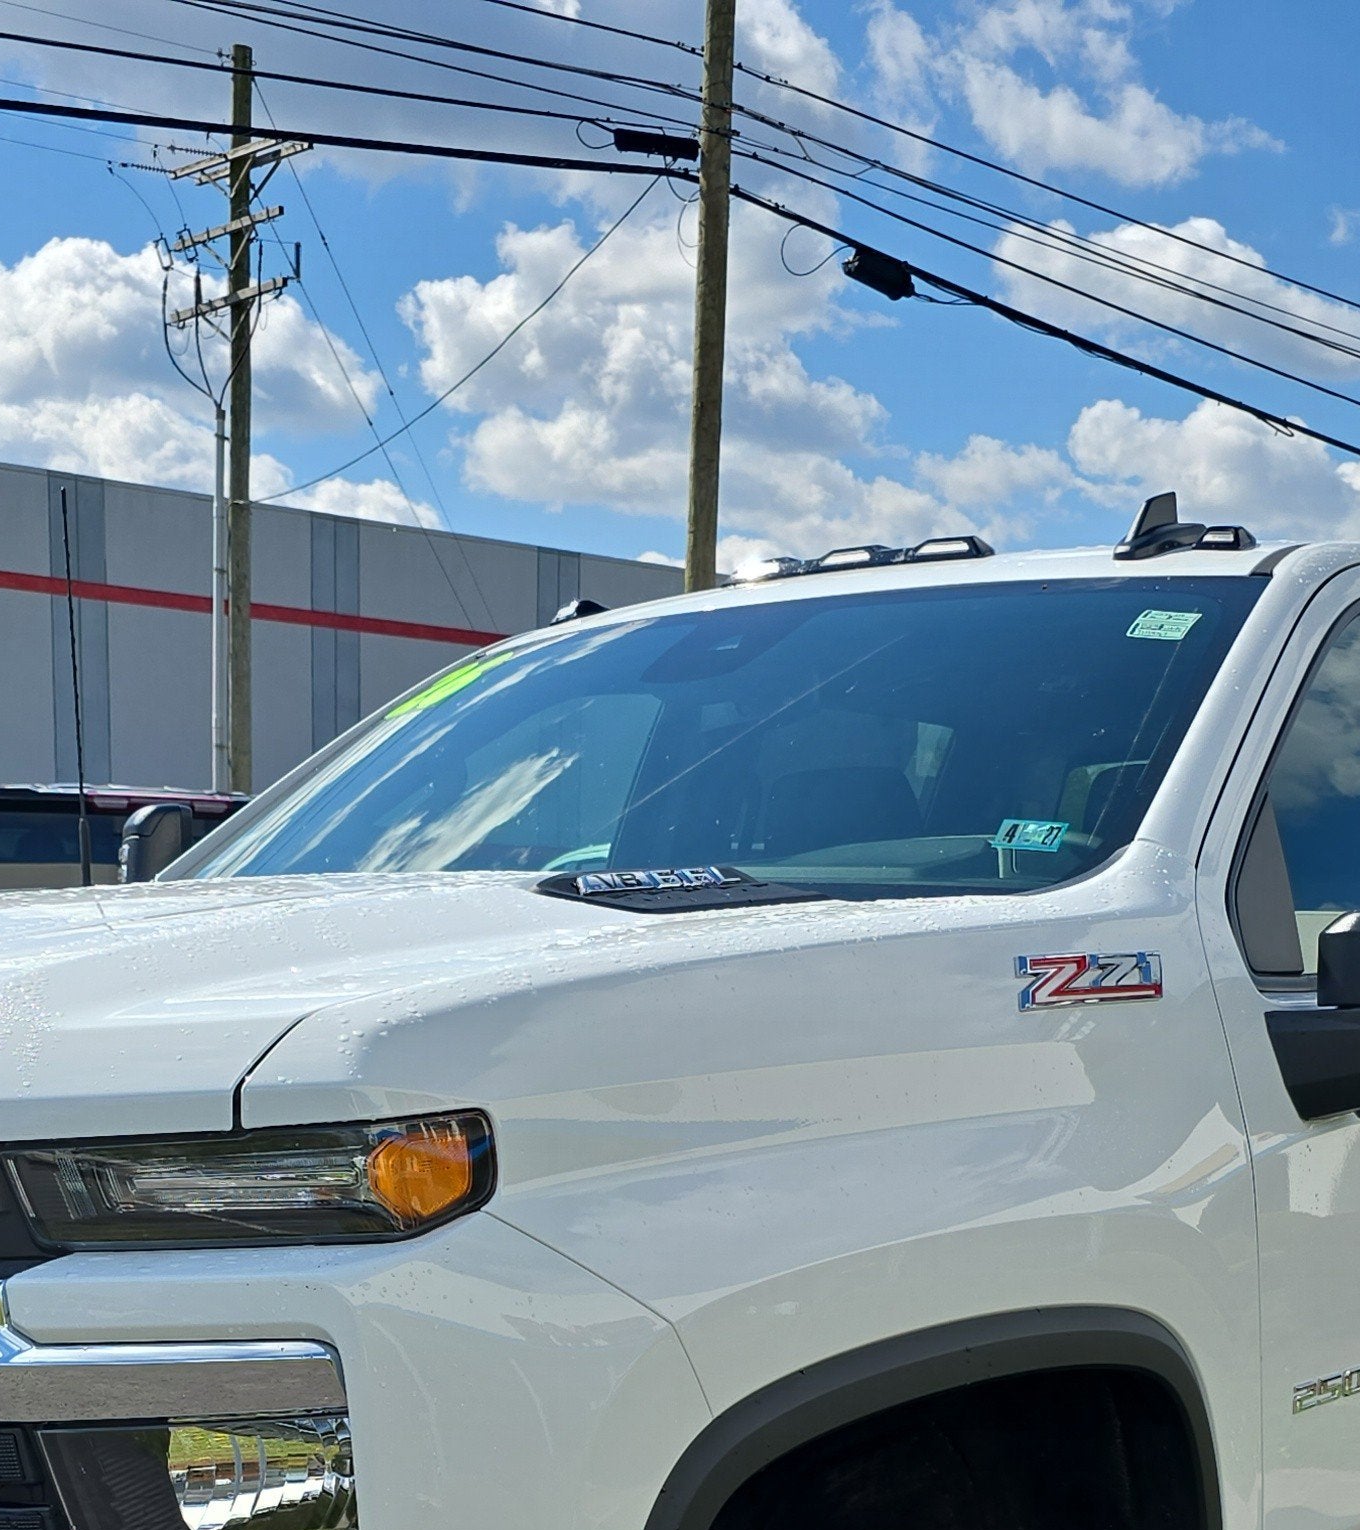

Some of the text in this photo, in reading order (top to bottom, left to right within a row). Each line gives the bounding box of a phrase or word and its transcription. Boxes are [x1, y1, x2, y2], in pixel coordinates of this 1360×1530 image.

[1002, 823, 1062, 847] 4 27
[592, 872, 643, 889] V8
[1014, 951, 1163, 1012] Z71
